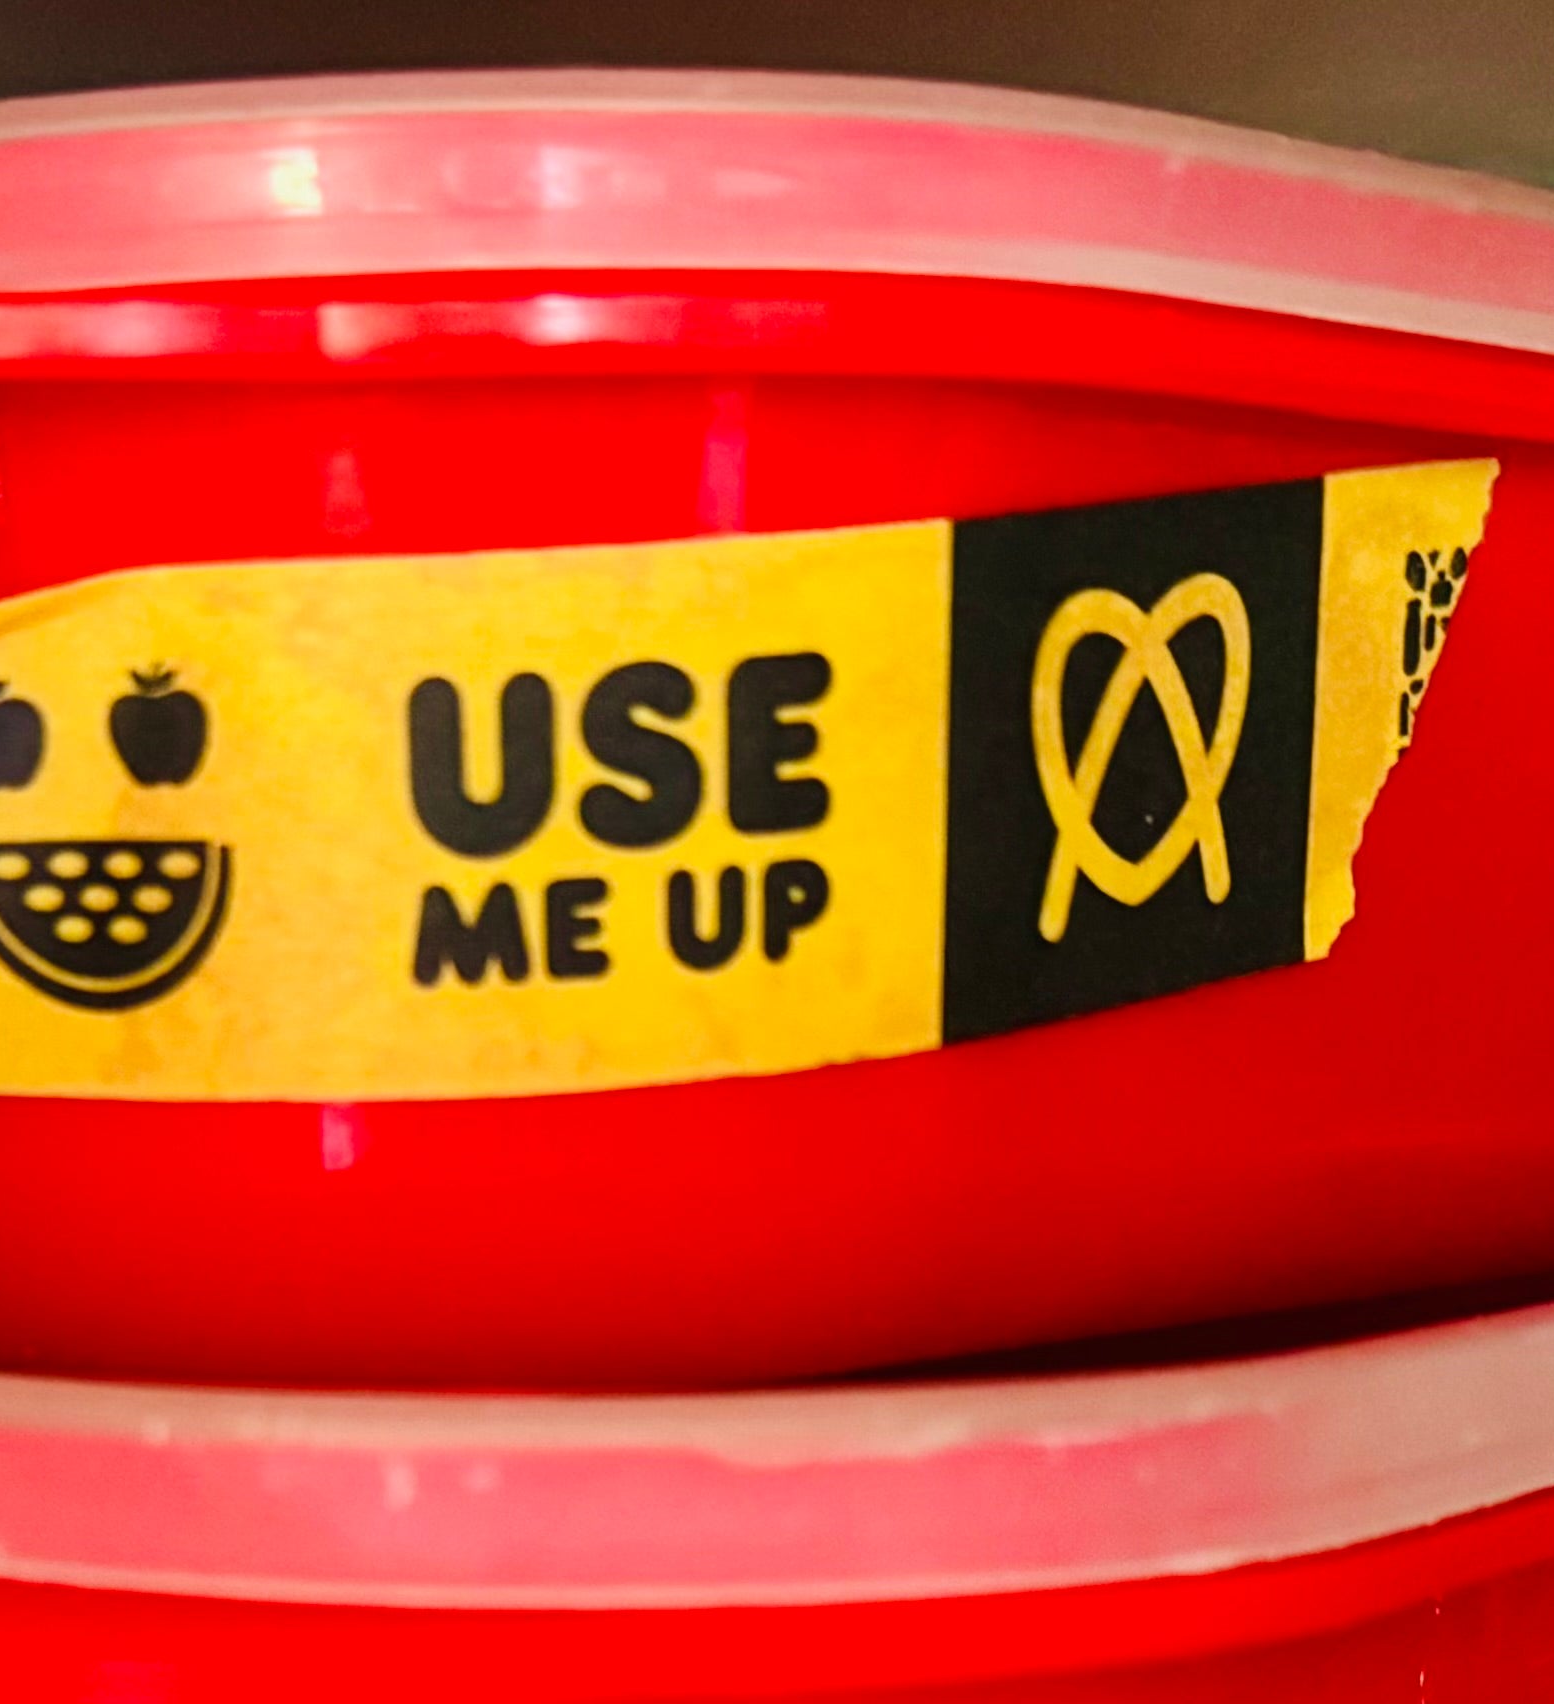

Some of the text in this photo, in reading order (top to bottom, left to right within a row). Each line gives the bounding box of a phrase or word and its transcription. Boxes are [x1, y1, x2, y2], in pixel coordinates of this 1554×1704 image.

[407, 650, 834, 859] USE
[412, 859, 831, 987] ME UP
